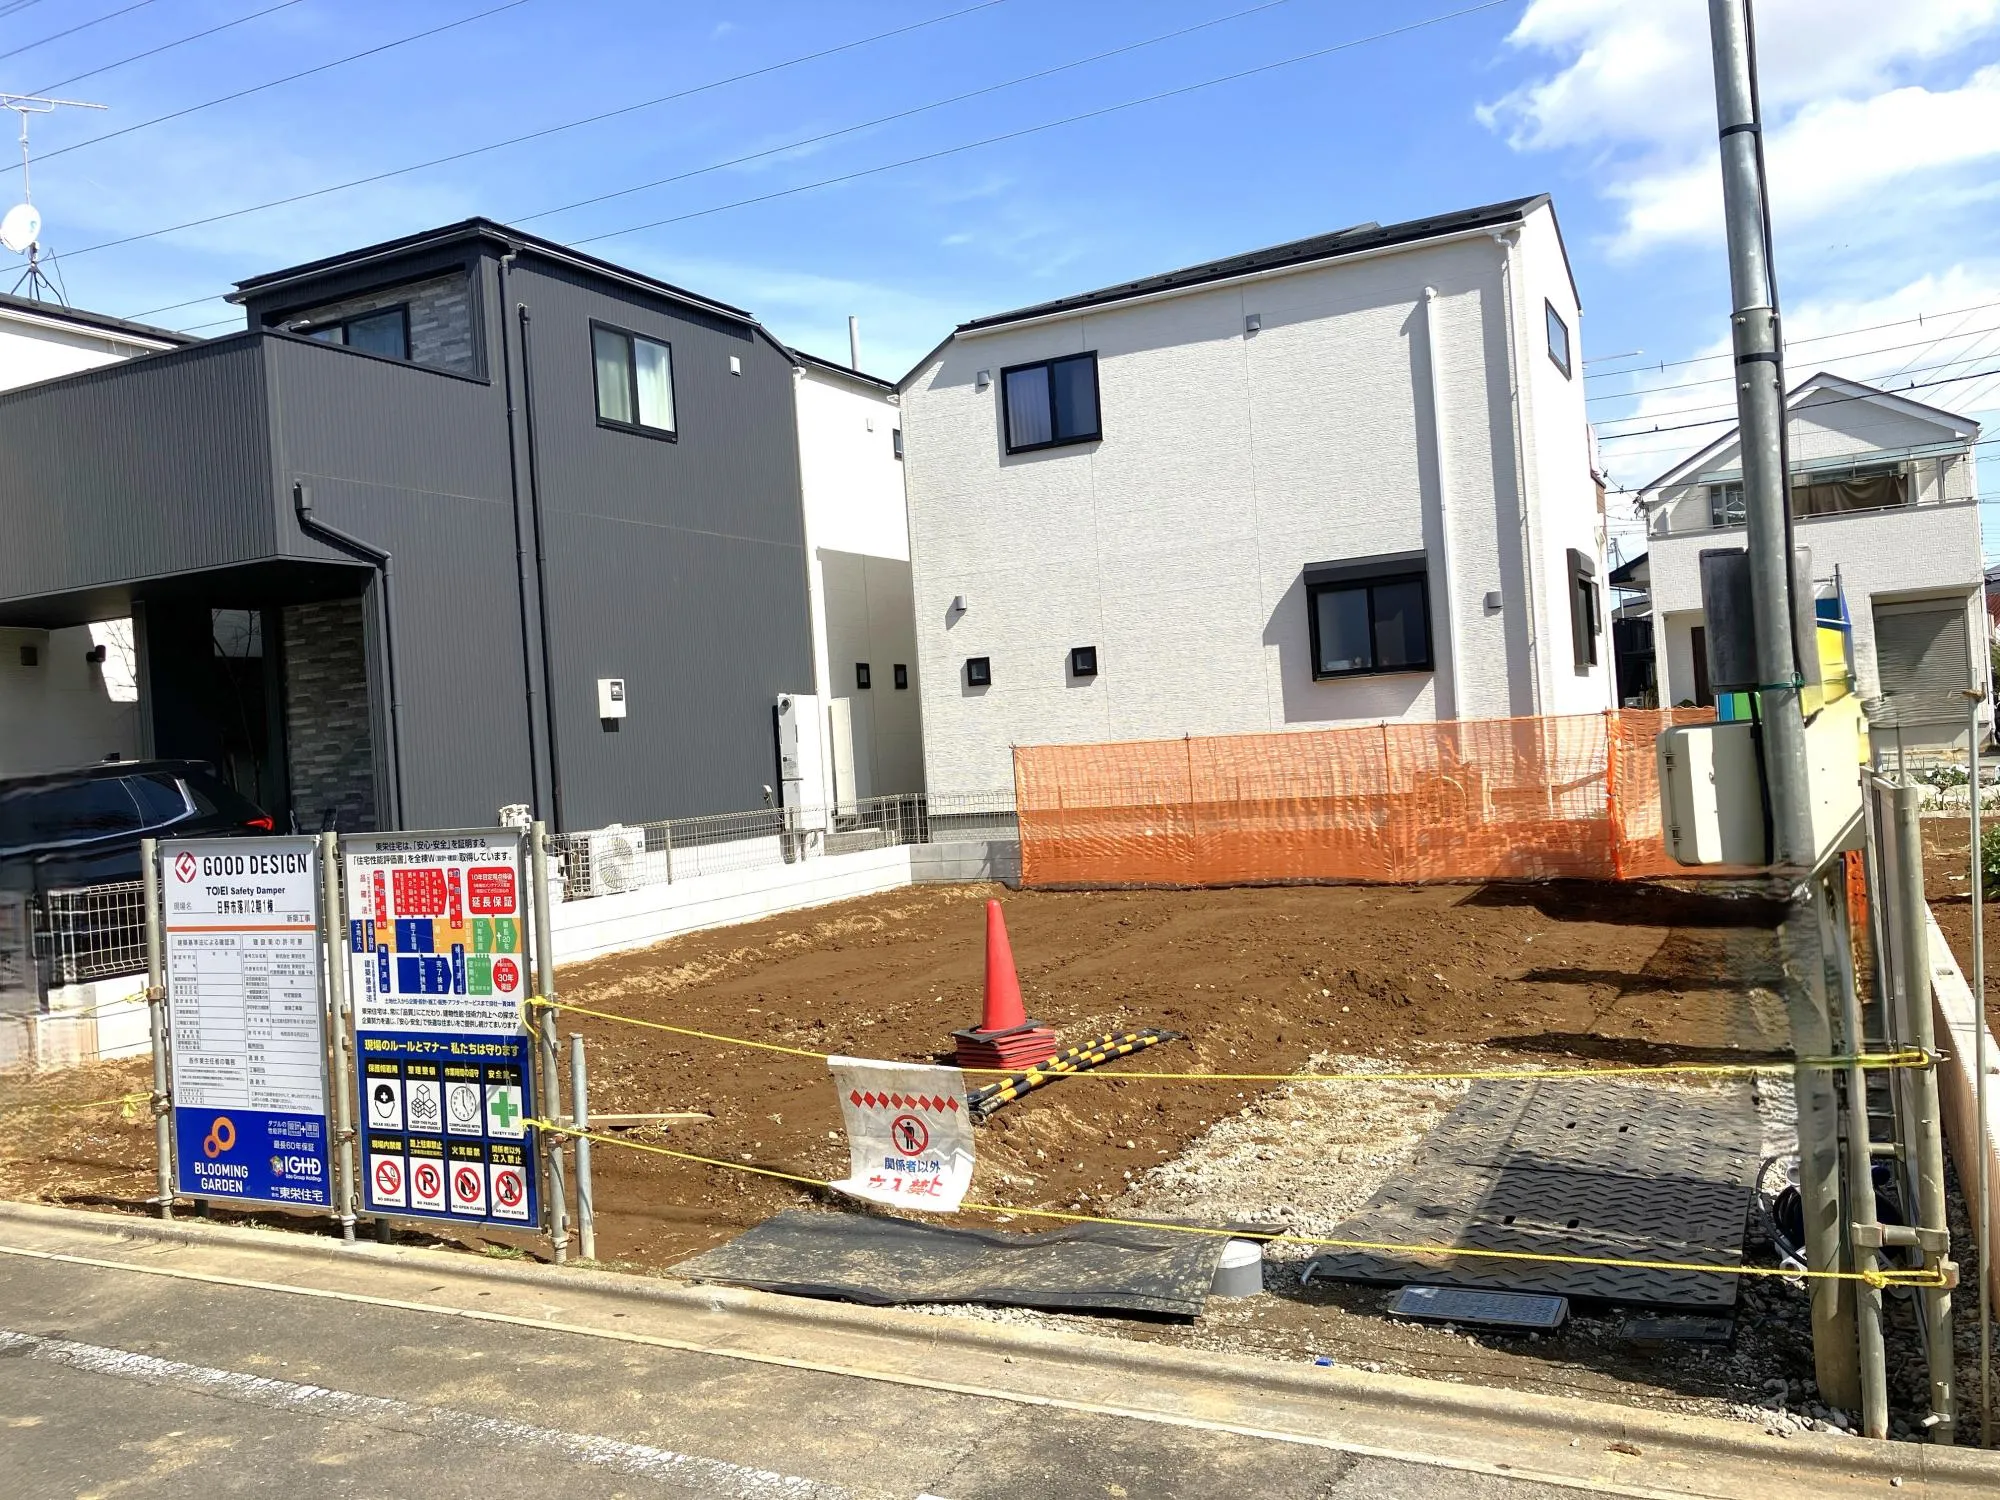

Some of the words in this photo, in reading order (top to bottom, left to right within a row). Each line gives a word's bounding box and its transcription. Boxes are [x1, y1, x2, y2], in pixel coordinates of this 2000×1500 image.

[203, 856, 244, 876] GOOD
[250, 853, 307, 875] DESIGN
[230, 887, 254, 896] Safety
[256, 886, 286, 896] Damper
[472, 896, 512, 908] 延長保証
[436, 960, 444, 992] 完了検査
[498, 974, 514, 982] 30年
[364, 1040, 448, 1053] 現場のルールとマナー
[451, 1042, 520, 1057] 私たちは守ります
[452, 1146, 480, 1157] 火気厳禁
[492, 1154, 522, 1165] 立入禁止
[884, 1156, 941, 1174] 関係者以外
[194, 1162, 248, 1178] BLOOMING
[201, 1178, 242, 1192] GARDEN
[280, 1187, 324, 1202] 東栄住宅
